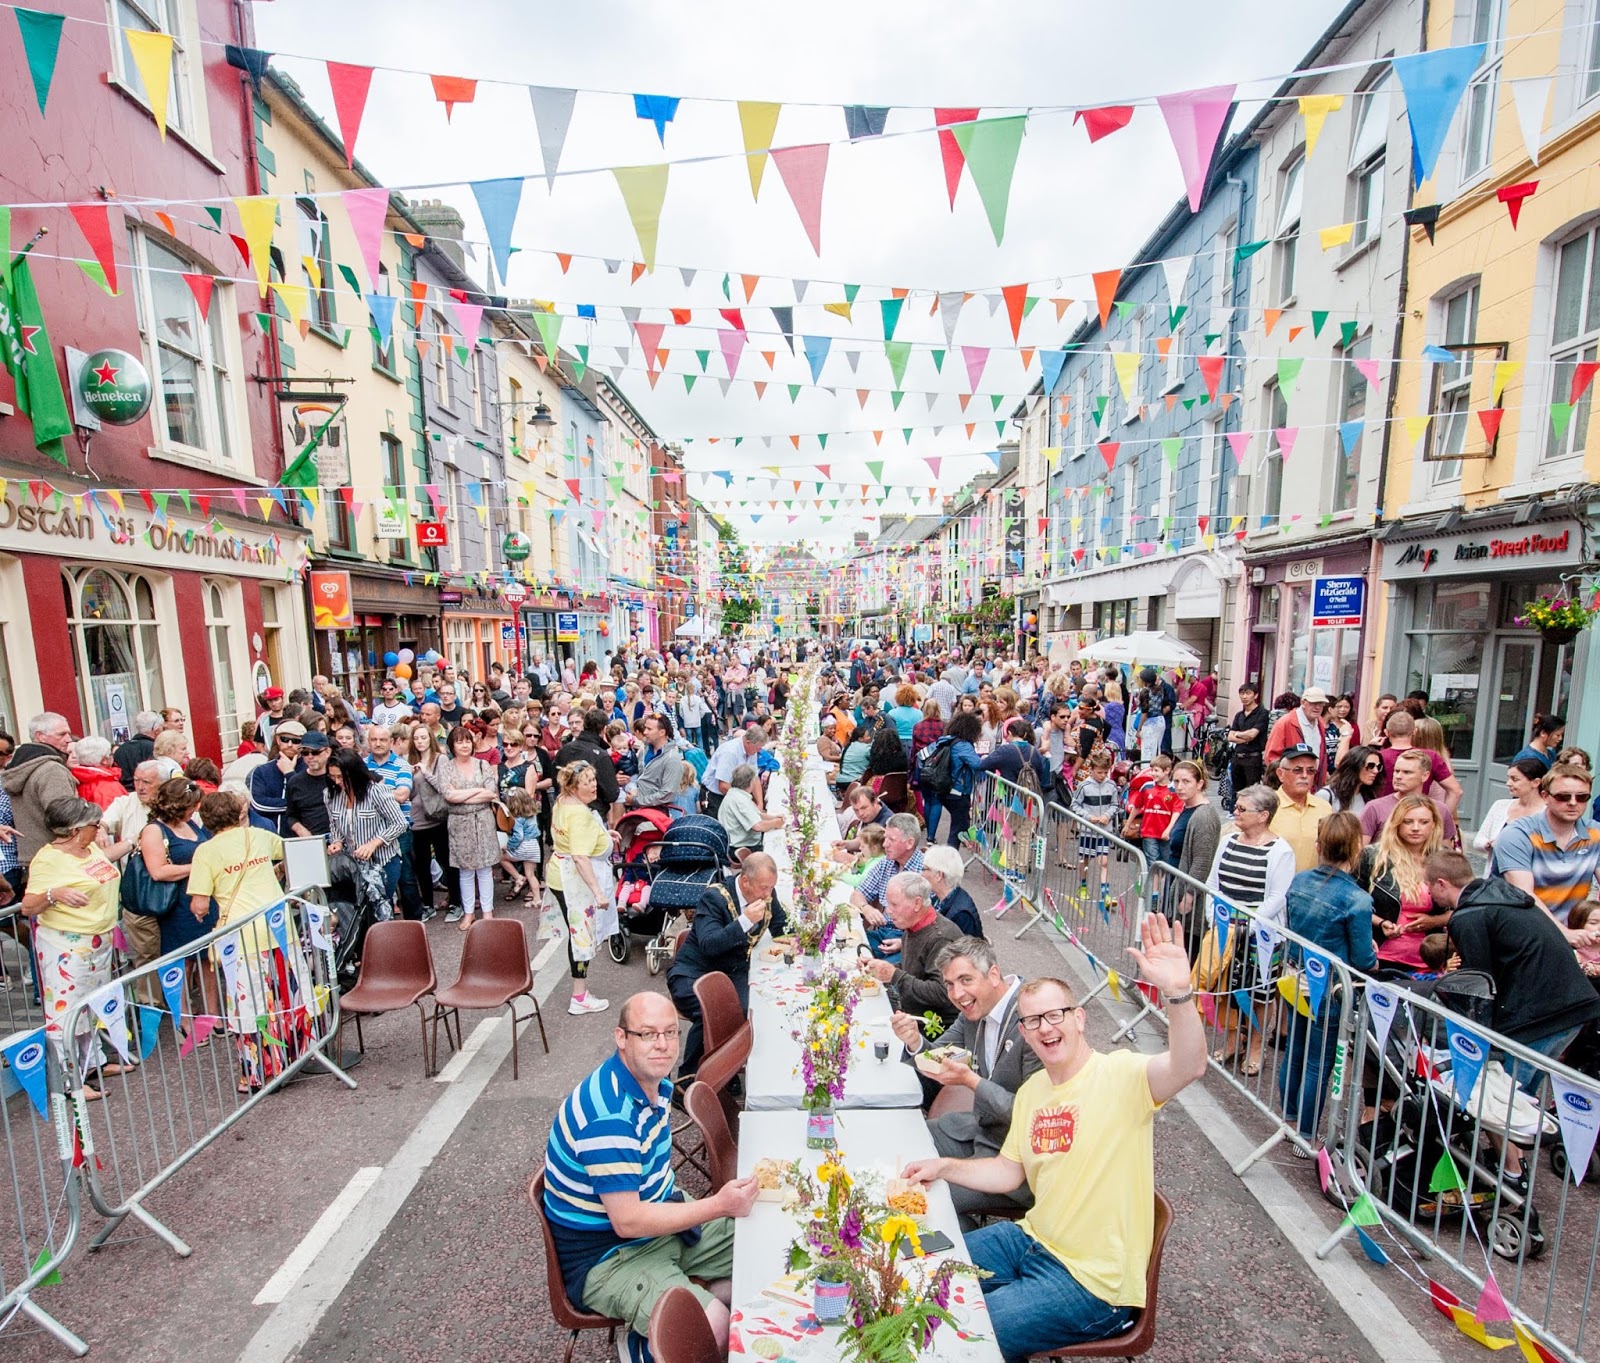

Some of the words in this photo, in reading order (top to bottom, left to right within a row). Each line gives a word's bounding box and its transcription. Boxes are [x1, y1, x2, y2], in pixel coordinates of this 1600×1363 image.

[84, 389, 142, 402] Heineken
[1453, 542, 1489, 561] Asian
[1489, 536, 1529, 558] Street
[1530, 529, 1569, 552] Food
[1326, 580, 1351, 589] Sherry
[508, 594, 523, 602] BUS
[1320, 587, 1357, 597] FitzGerald
[378, 713, 397, 725] 62
[1332, 1044, 1345, 1095] HAYES
[1567, 1095, 1589, 1110] Clóna
